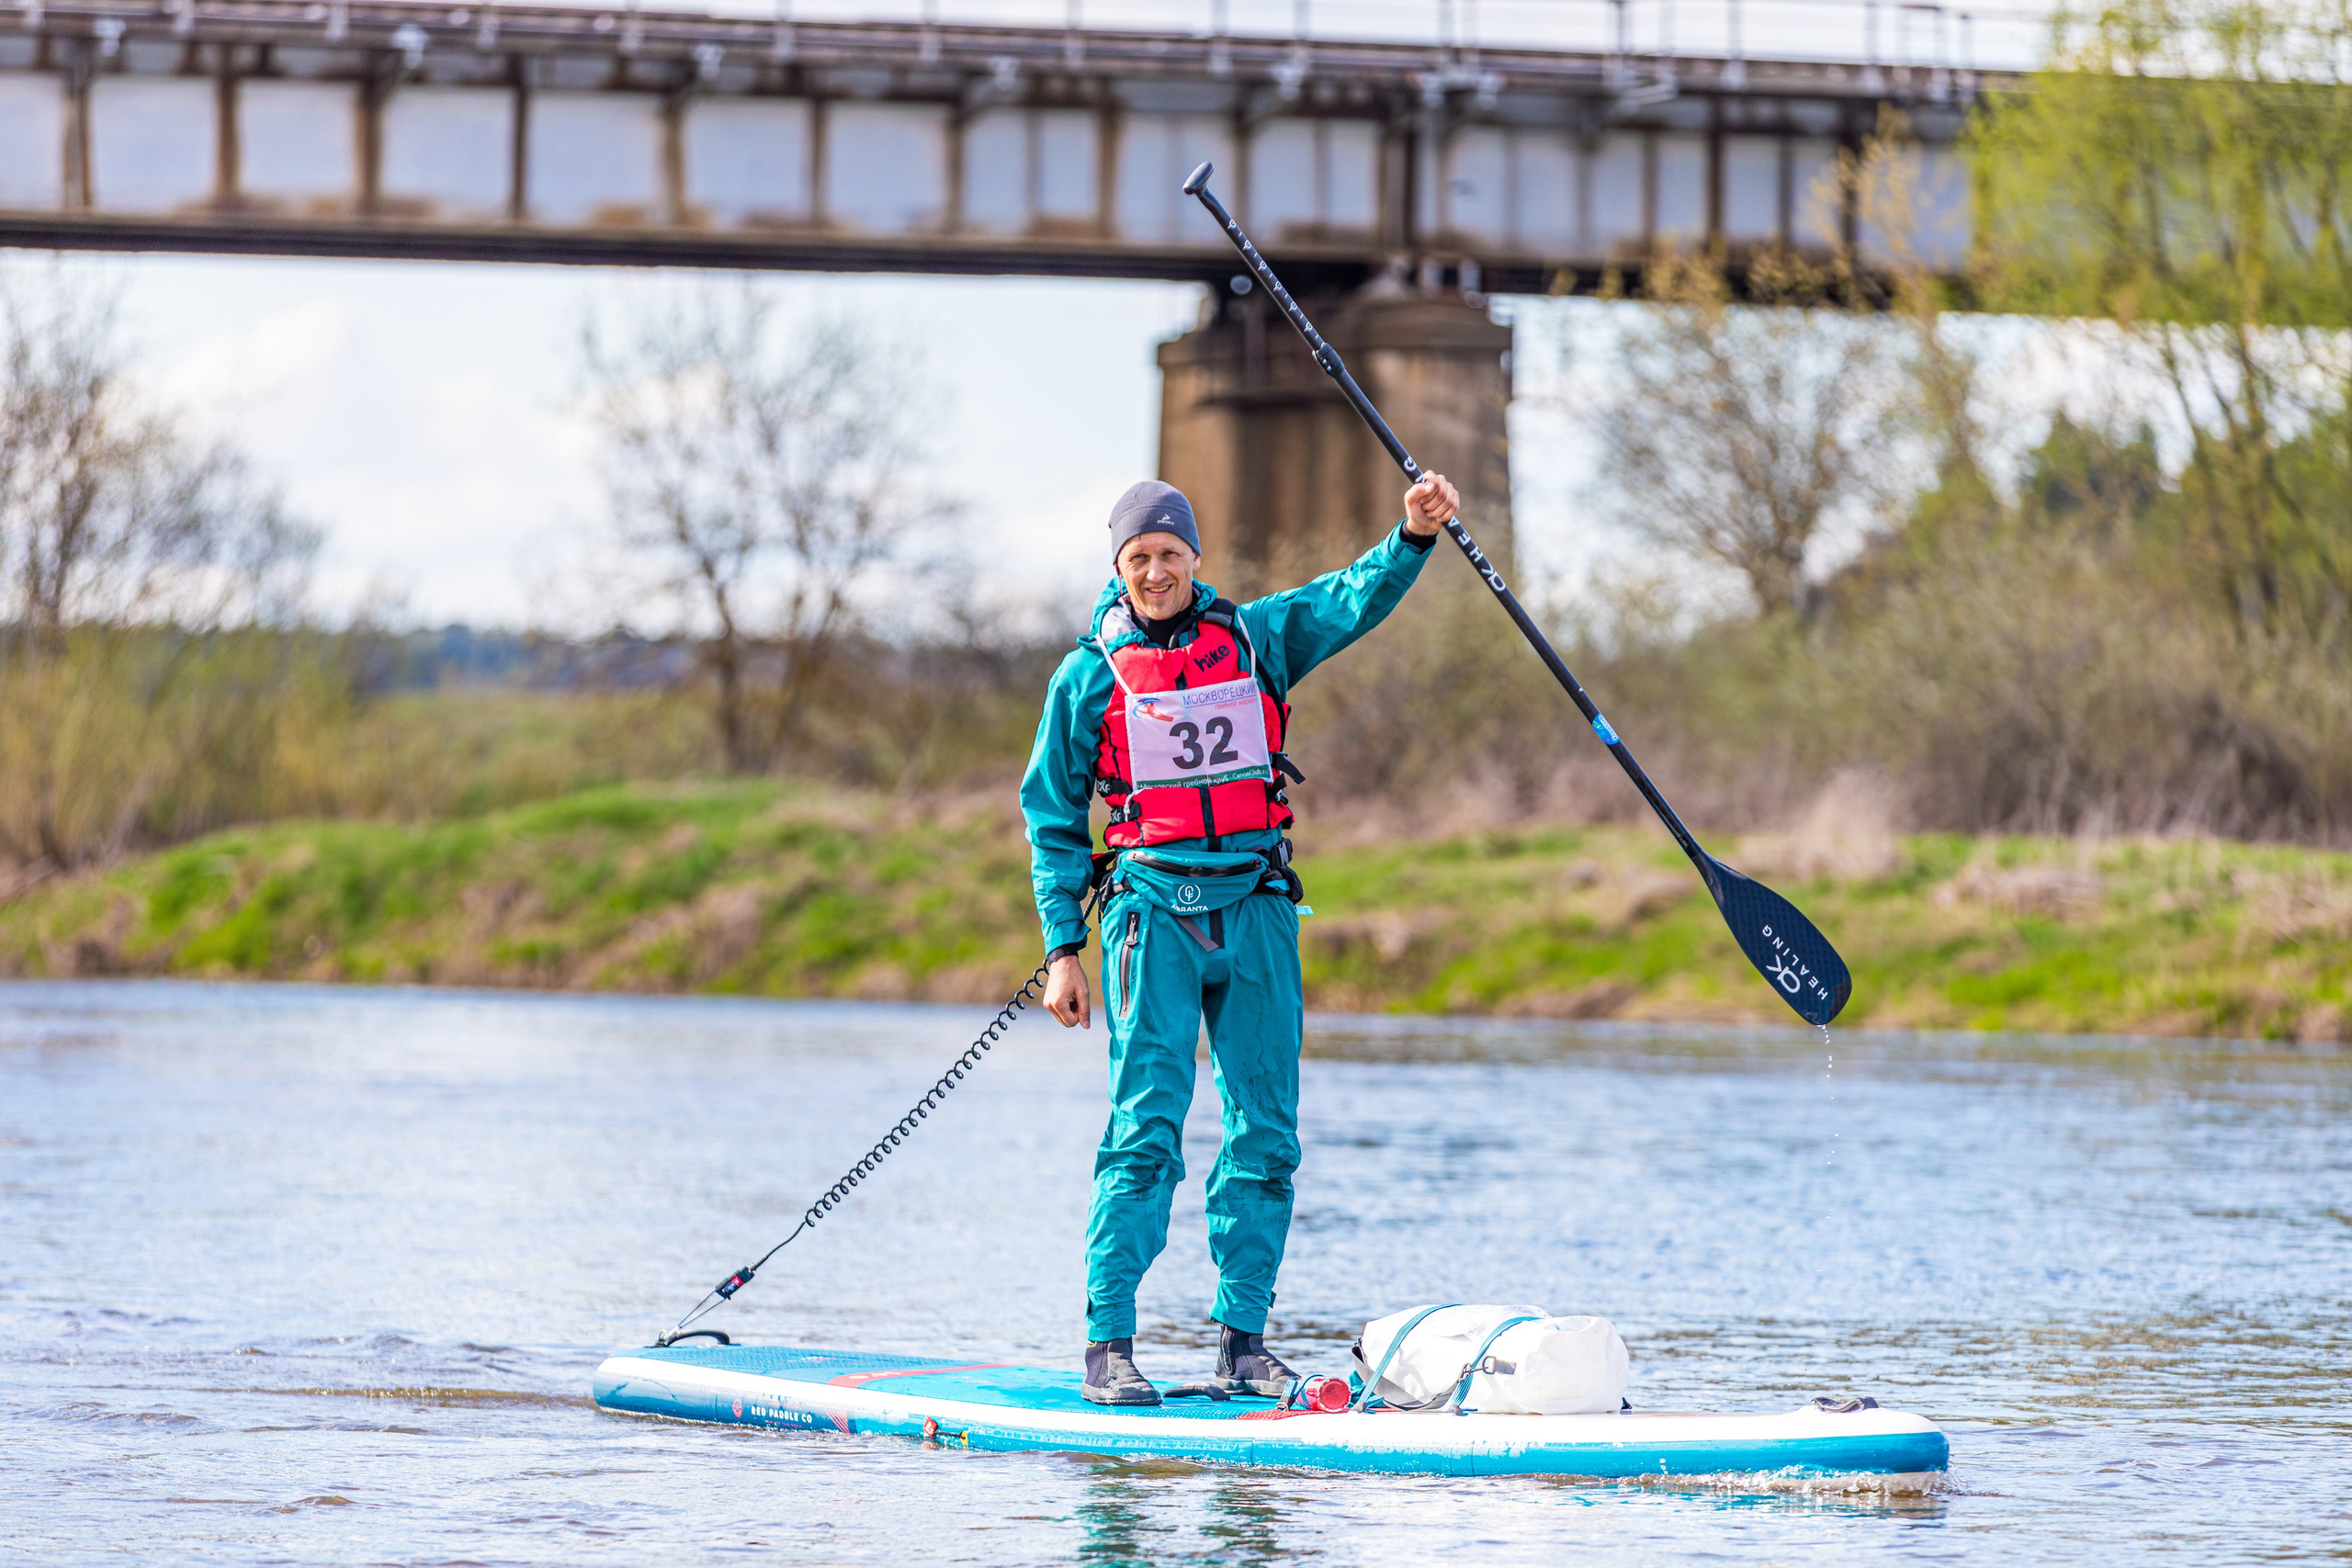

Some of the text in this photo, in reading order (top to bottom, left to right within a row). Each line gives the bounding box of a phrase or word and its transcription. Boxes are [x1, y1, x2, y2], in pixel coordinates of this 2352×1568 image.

[1193, 644, 1231, 673] hike
[1182, 683, 1255, 705] МОСКВОРЕЦКИЙ
[1169, 716, 1238, 769] 32
[1761, 924, 1828, 1000] HEALING
[751, 1405, 766, 1416] RED
[769, 1408, 798, 1421] PADDLE
[801, 1413, 812, 1424] CO
